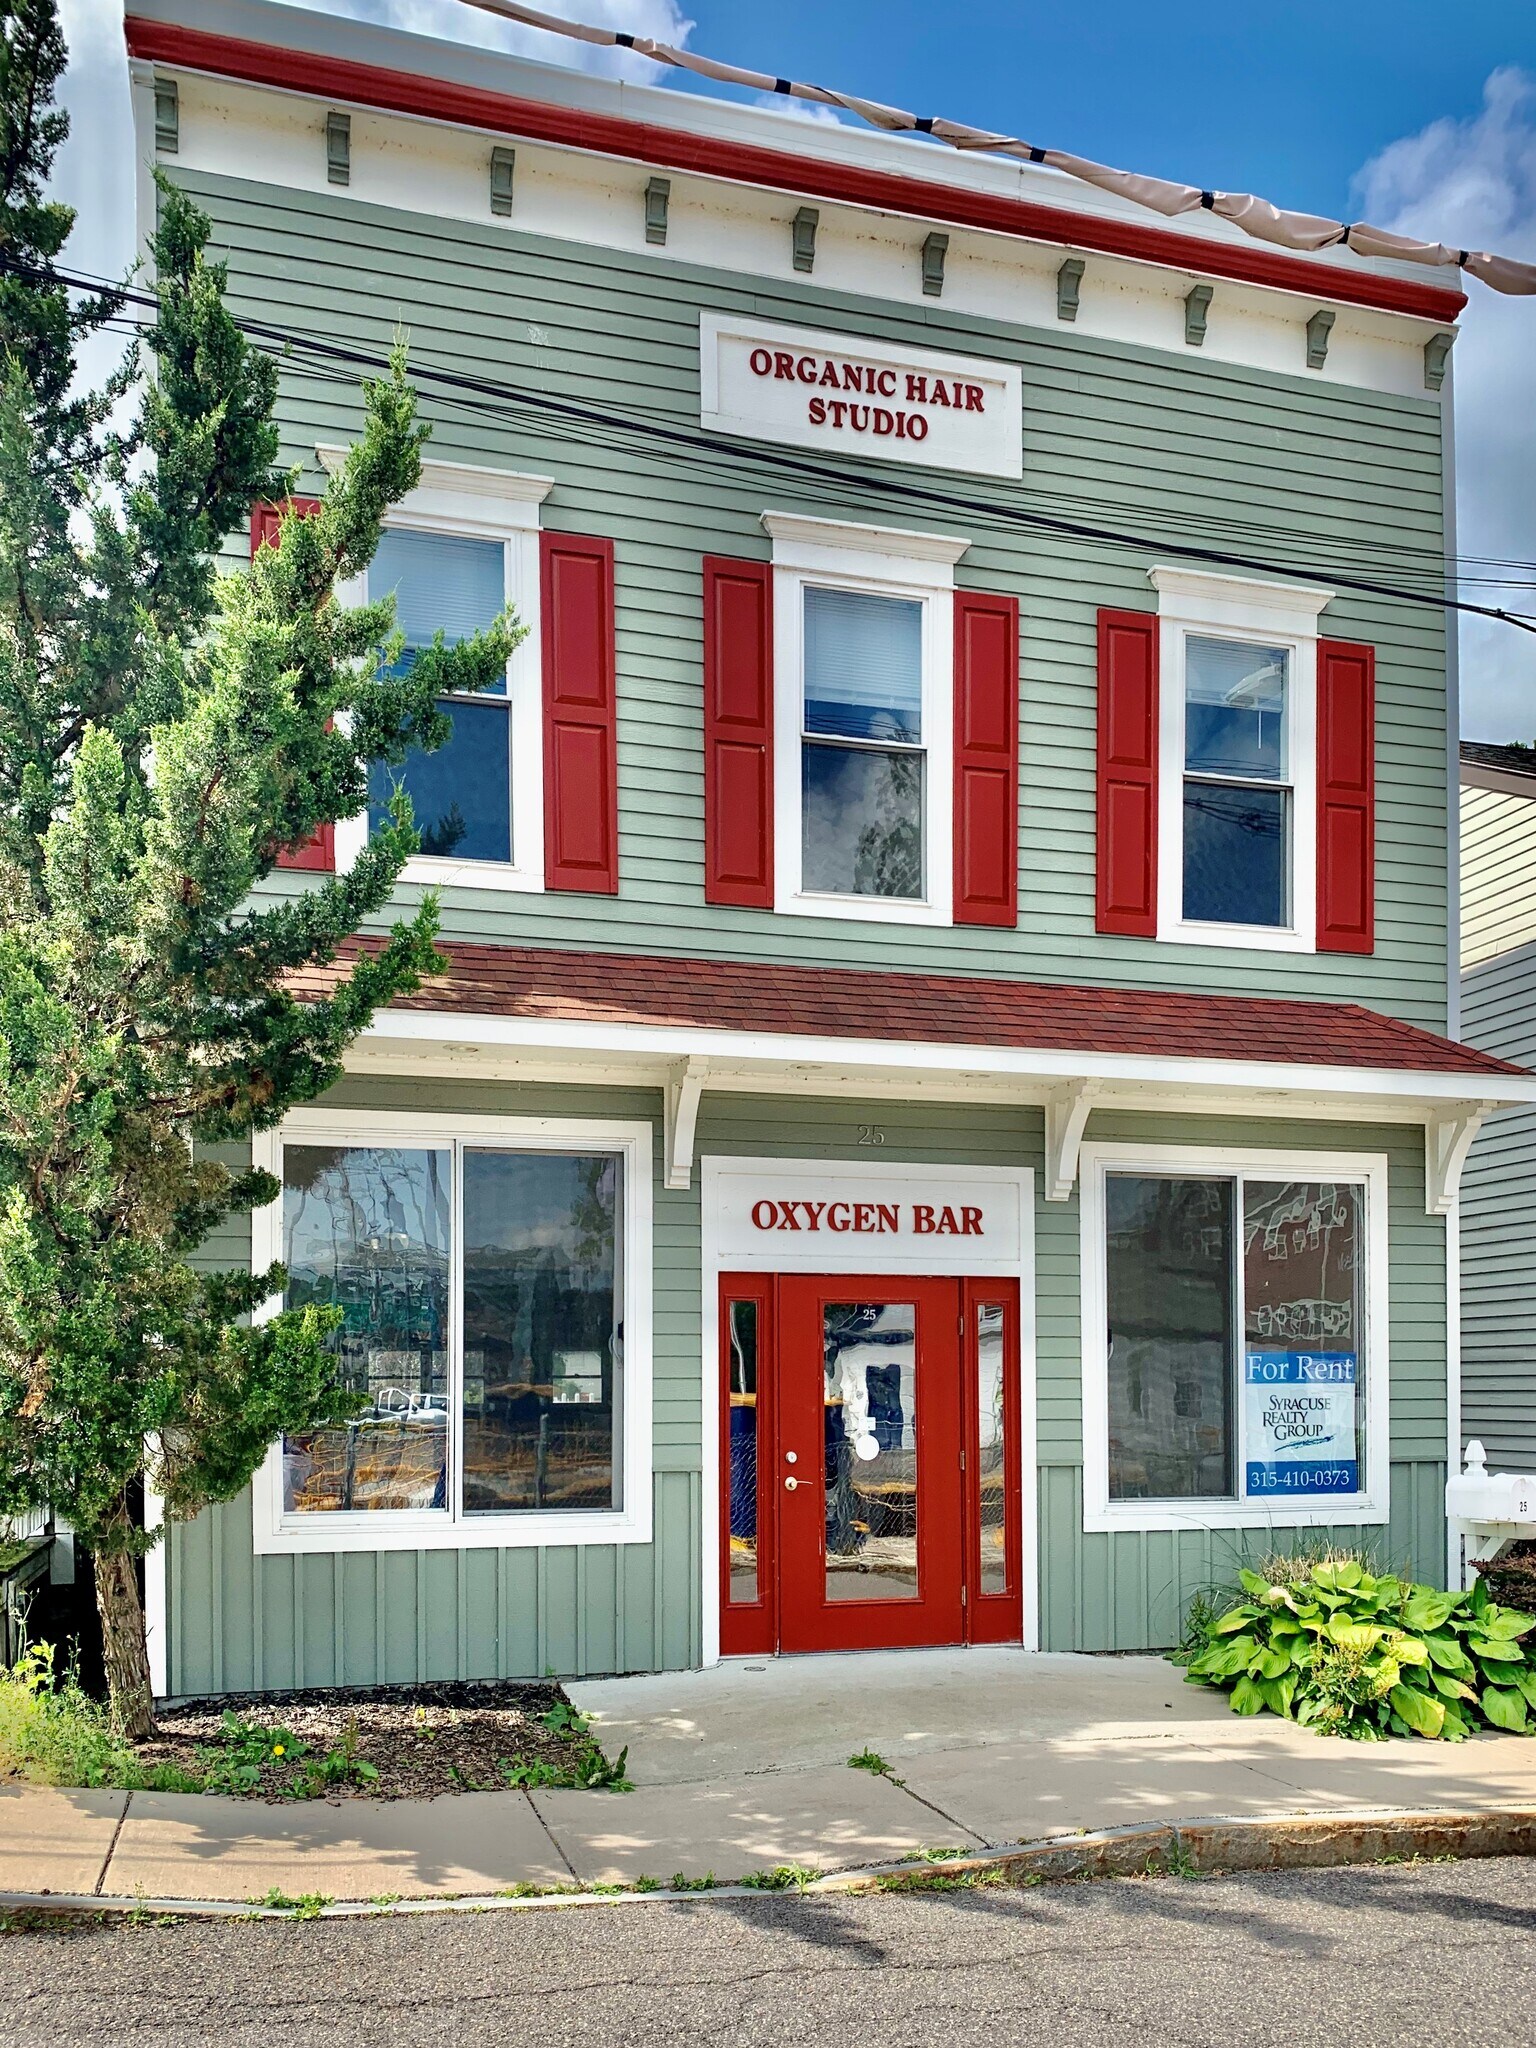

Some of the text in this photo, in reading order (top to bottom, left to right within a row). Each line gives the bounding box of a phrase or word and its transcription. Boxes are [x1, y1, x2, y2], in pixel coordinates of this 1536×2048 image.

[750, 348, 985, 412] ORGANIC HAIR
[809, 397, 928, 440] STUDIO
[857, 1125, 885, 1145] 25
[752, 1200, 984, 1235] OXYGEN BAR
[862, 1309, 877, 1321] 25
[1247, 1356, 1353, 1381] For Rent
[1269, 1394, 1331, 1411] SYRACUSE
[1262, 1410, 1308, 1428] REALTY
[1274, 1423, 1323, 1441] GROUP
[1251, 1470, 1349, 1487] 315-410-0373
[1519, 1501, 1528, 1512] 25
